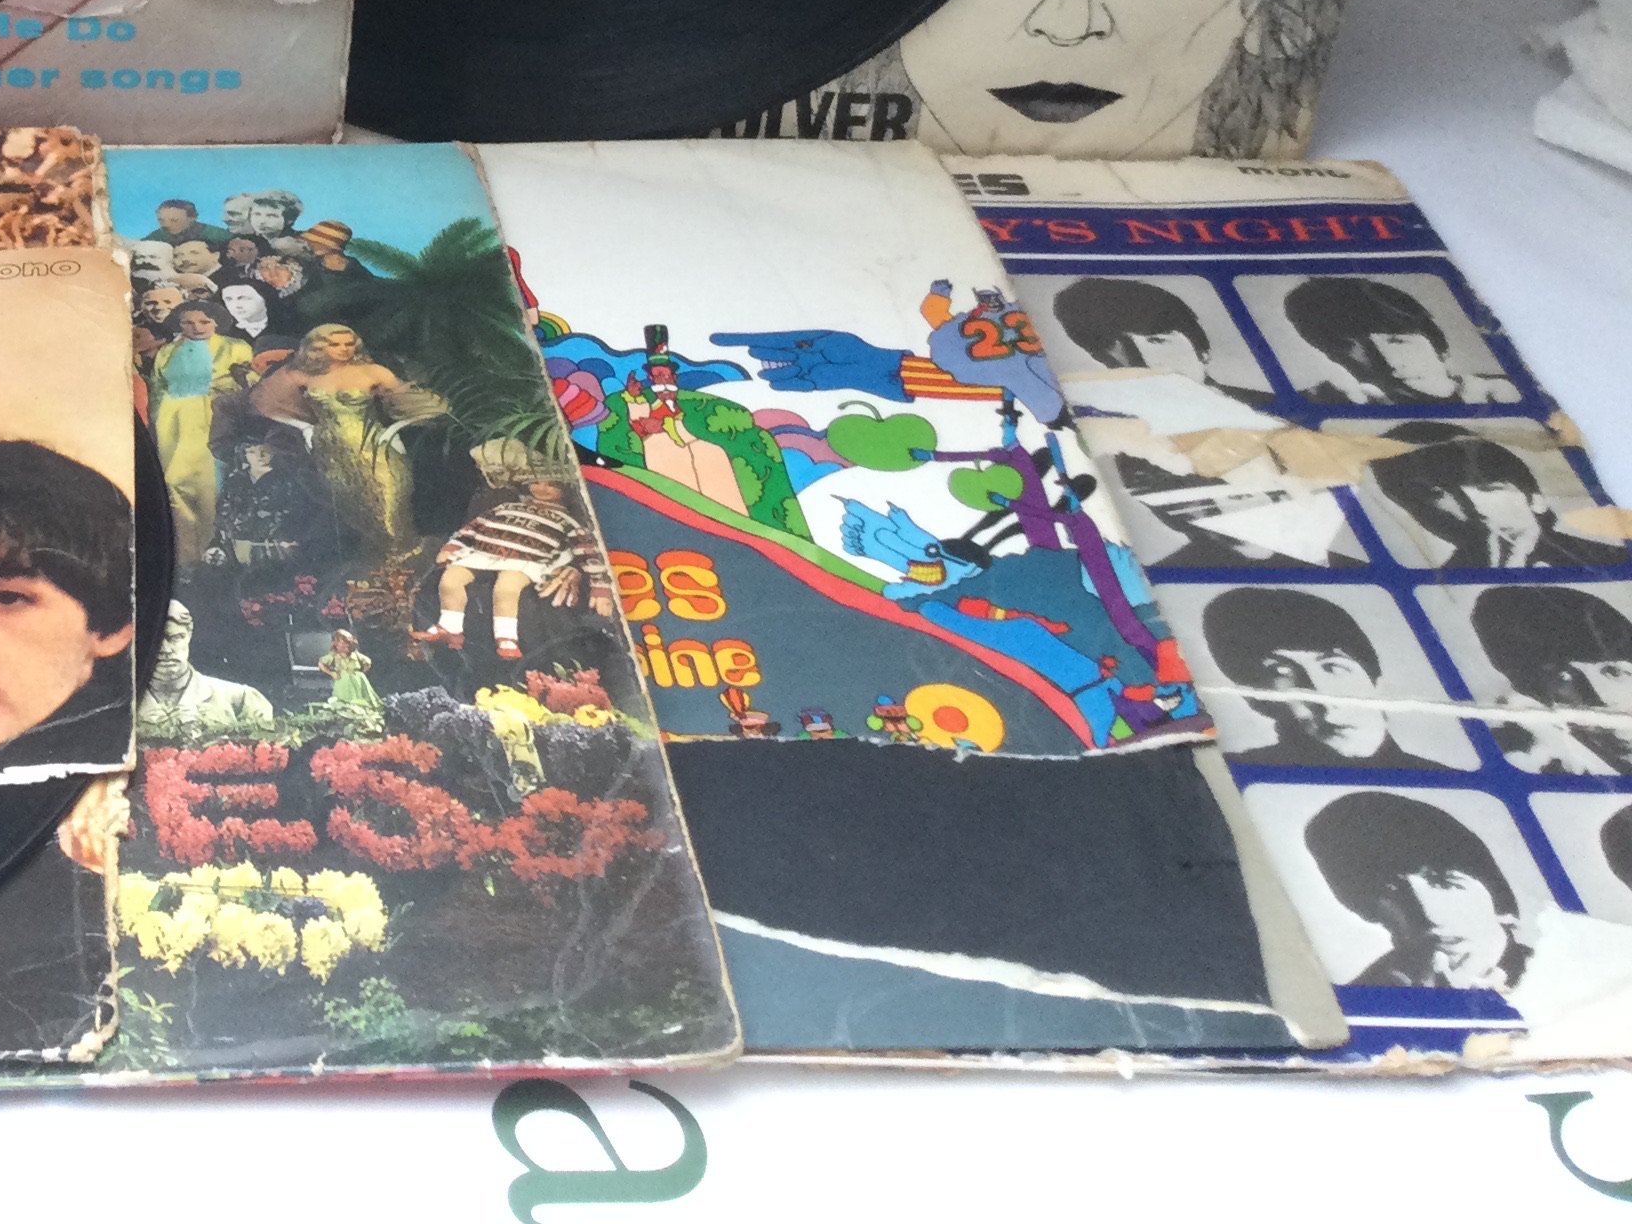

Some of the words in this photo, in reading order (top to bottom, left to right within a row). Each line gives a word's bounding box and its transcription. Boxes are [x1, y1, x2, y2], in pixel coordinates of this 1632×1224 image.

[67, 16, 137, 43] Do
[80, 66, 243, 95] songs
[1119, 213, 1404, 246] NIGHT
